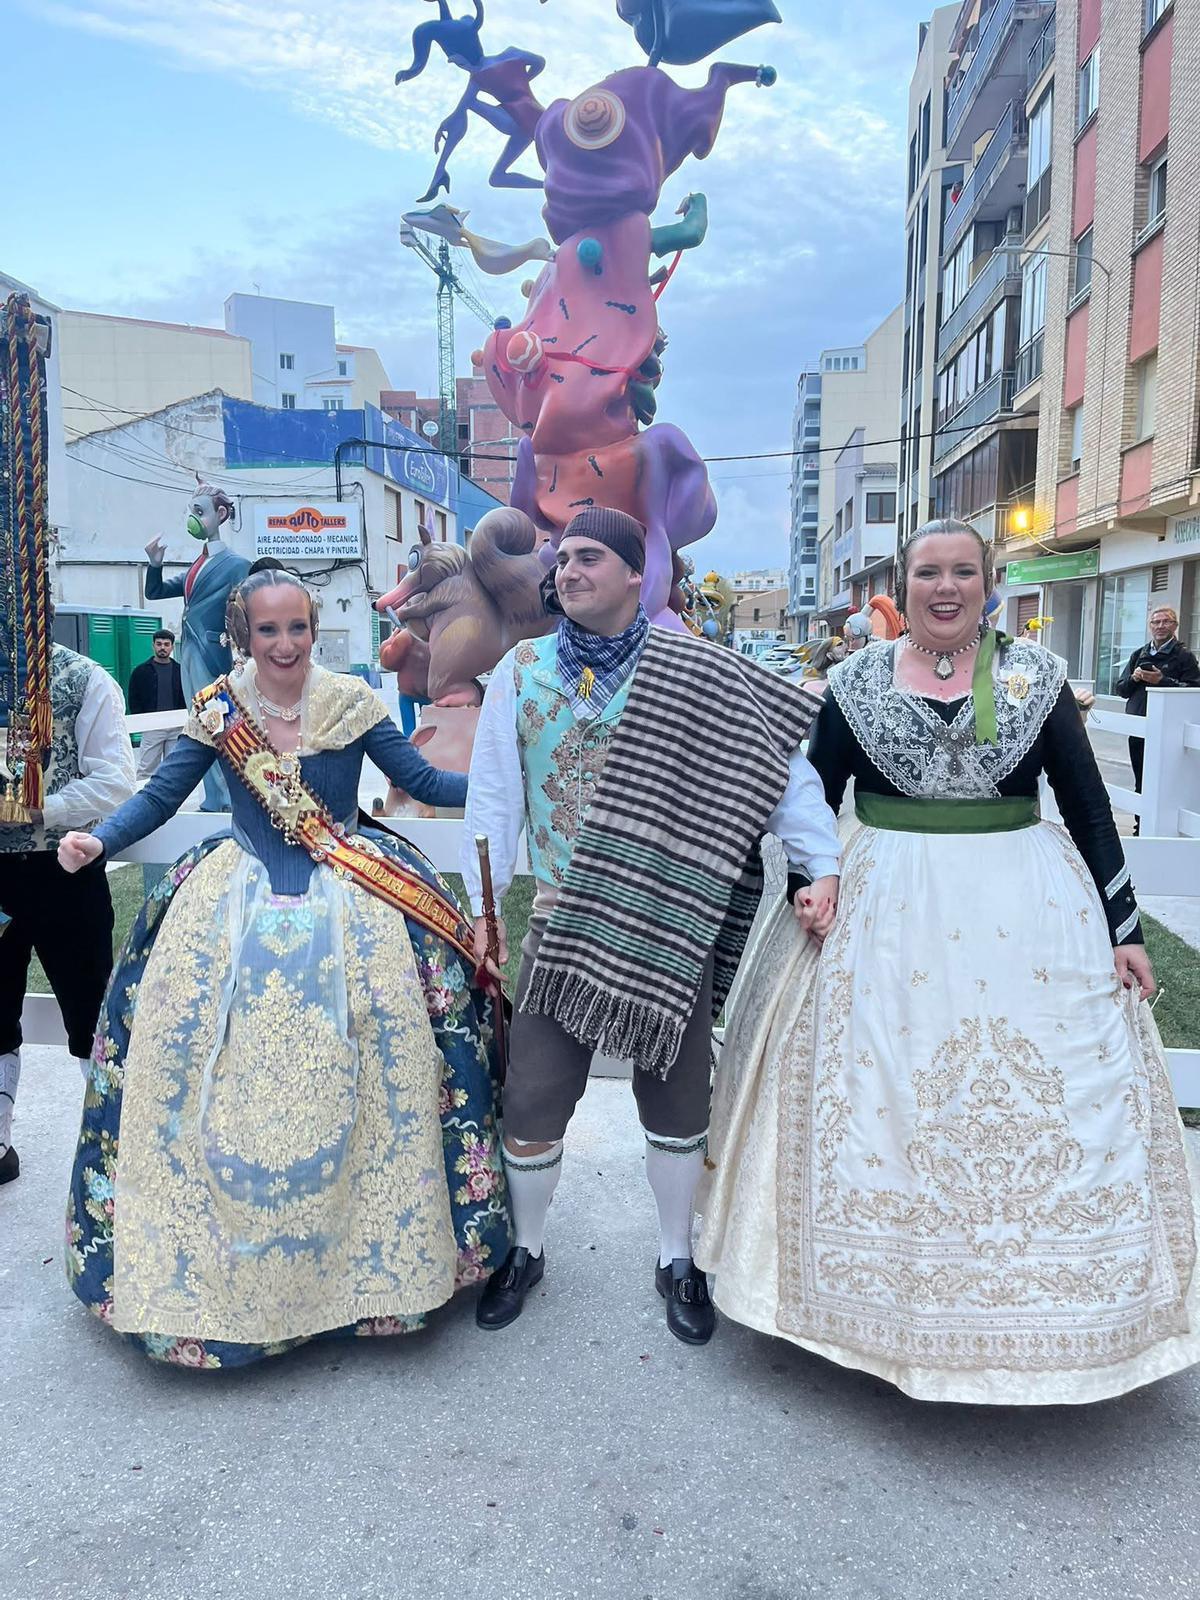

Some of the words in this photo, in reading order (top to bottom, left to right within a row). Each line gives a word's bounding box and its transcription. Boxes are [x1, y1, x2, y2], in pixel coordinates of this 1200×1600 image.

[268, 518, 287, 526] REPAR
[289, 511, 319, 529] AUTO
[320, 517, 346, 526] TALLERS
[257, 535, 271, 544] AIRE
[272, 535, 323, 544] ACONDICIONADO
[327, 535, 359, 543] MECANICA
[257, 546, 300, 555] ELECTRICIDAD
[304, 546, 325, 555] CHAPA
[326, 546, 331, 554] Y
[331, 546, 358, 554] PINTURA
